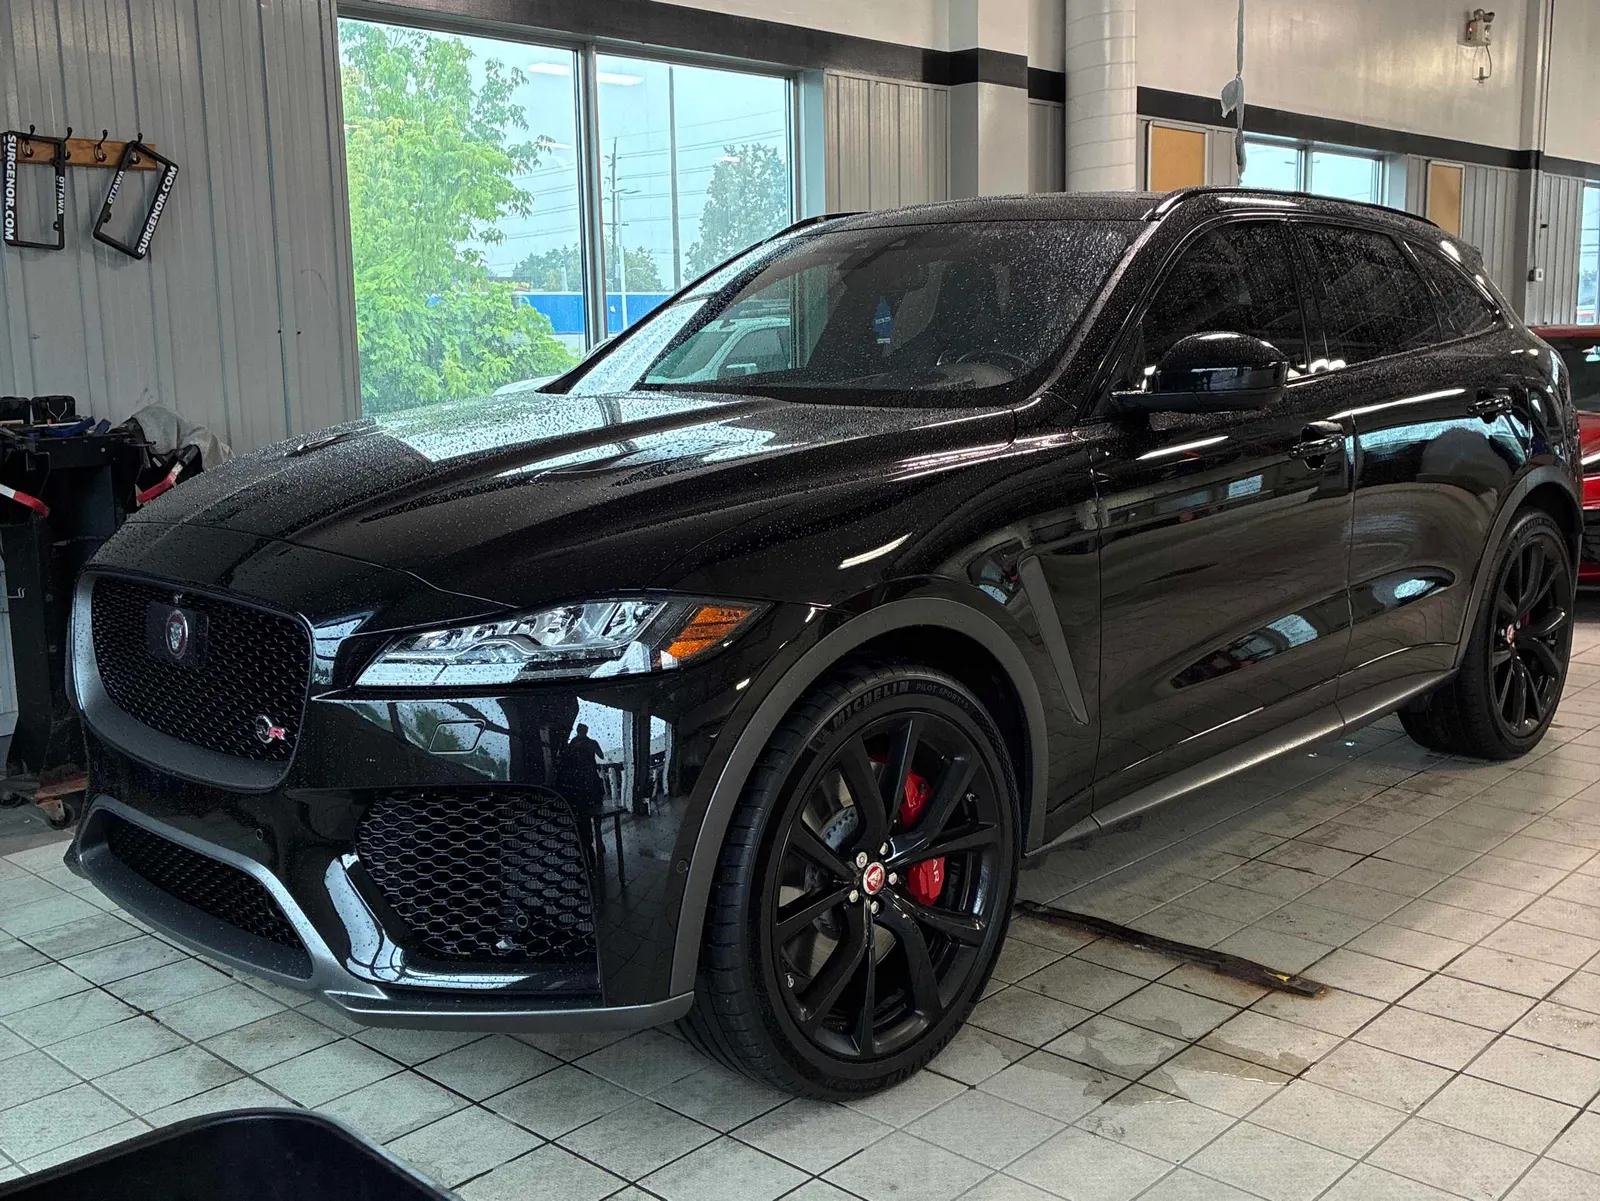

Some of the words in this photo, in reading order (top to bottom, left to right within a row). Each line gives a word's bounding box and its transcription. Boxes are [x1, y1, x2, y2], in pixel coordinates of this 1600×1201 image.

[5, 134, 17, 240] SURGENOR.COM
[107, 170, 125, 204] OTTAWA
[137, 166, 178, 255] SURGENOR.COM
[832, 681, 909, 727] MICHELIN
[915, 682, 937, 693] PILOT
